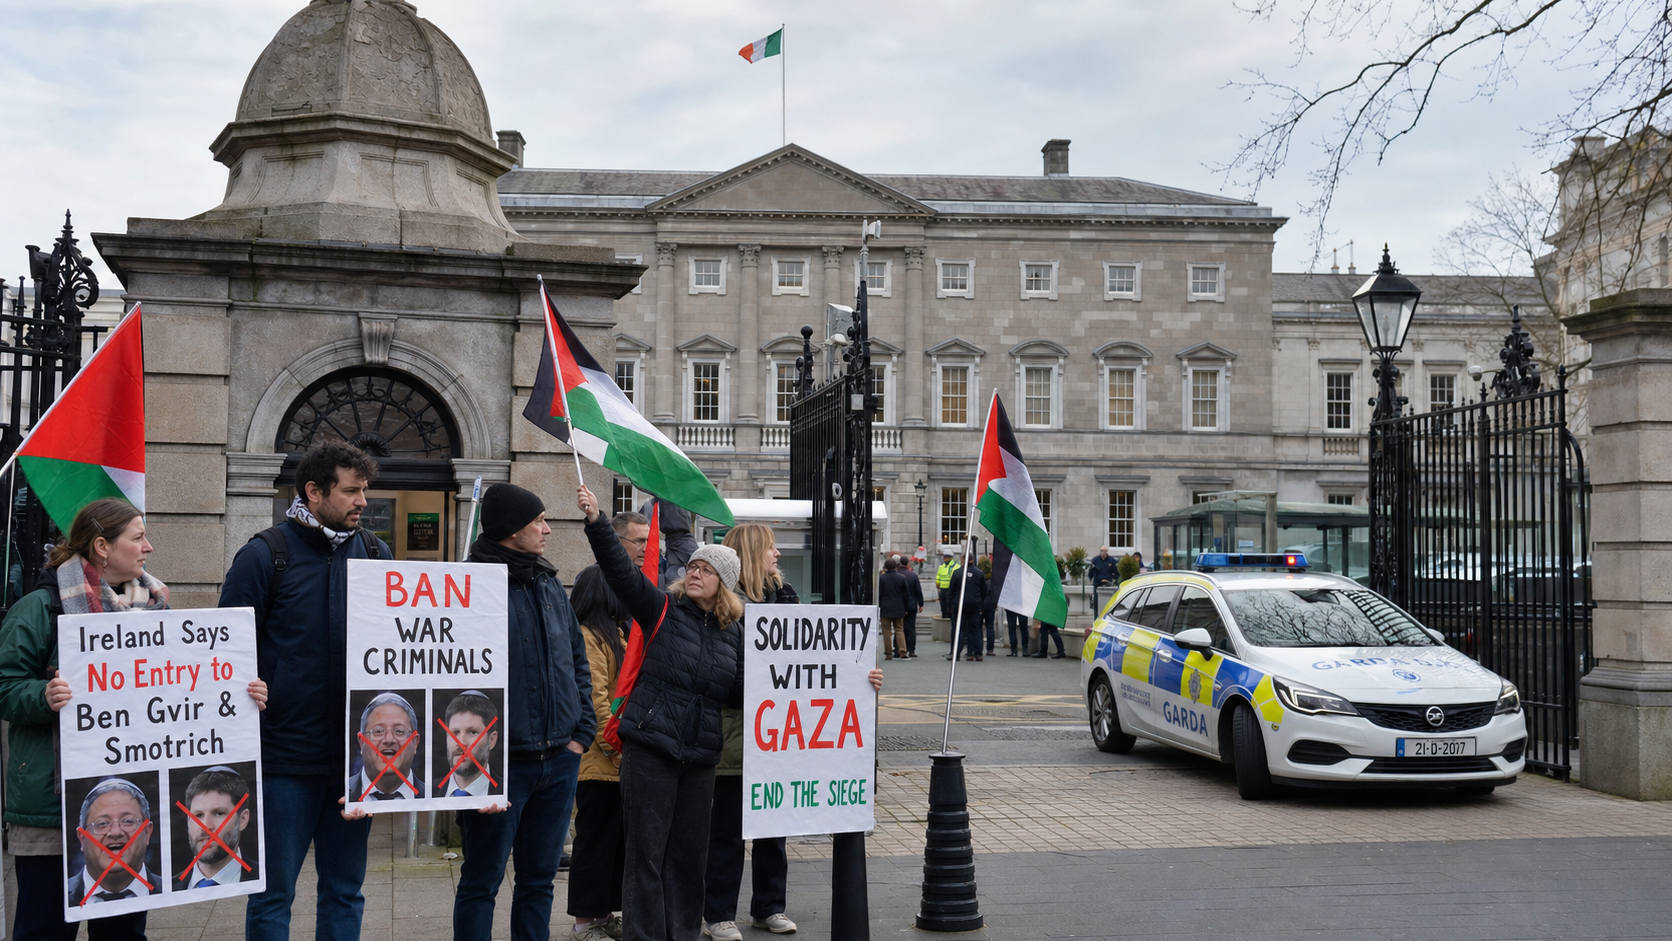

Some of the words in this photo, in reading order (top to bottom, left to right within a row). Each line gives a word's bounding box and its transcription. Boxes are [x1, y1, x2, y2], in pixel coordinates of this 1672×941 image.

[385, 571, 471, 608] BAN
[79, 621, 165, 652] Ireland
[181, 619, 230, 650] Says
[394, 617, 455, 643] WAR
[754, 616, 871, 651] SOLIDARITY
[87, 662, 125, 692] No
[134, 658, 201, 692] Entry
[210, 656, 234, 681] to
[363, 647, 493, 675] CRIMINALS
[769, 664, 837, 689] WITH
[76, 703, 130, 731] Ben
[147, 696, 204, 724] Gvir
[218, 690, 237, 718] &
[754, 699, 864, 752] GAZA
[1163, 701, 1208, 737] GARDA
[104, 728, 224, 765] Smotrich
[751, 781, 784, 810] END
[790, 780, 819, 808] THE
[827, 779, 867, 806] SIEGE
